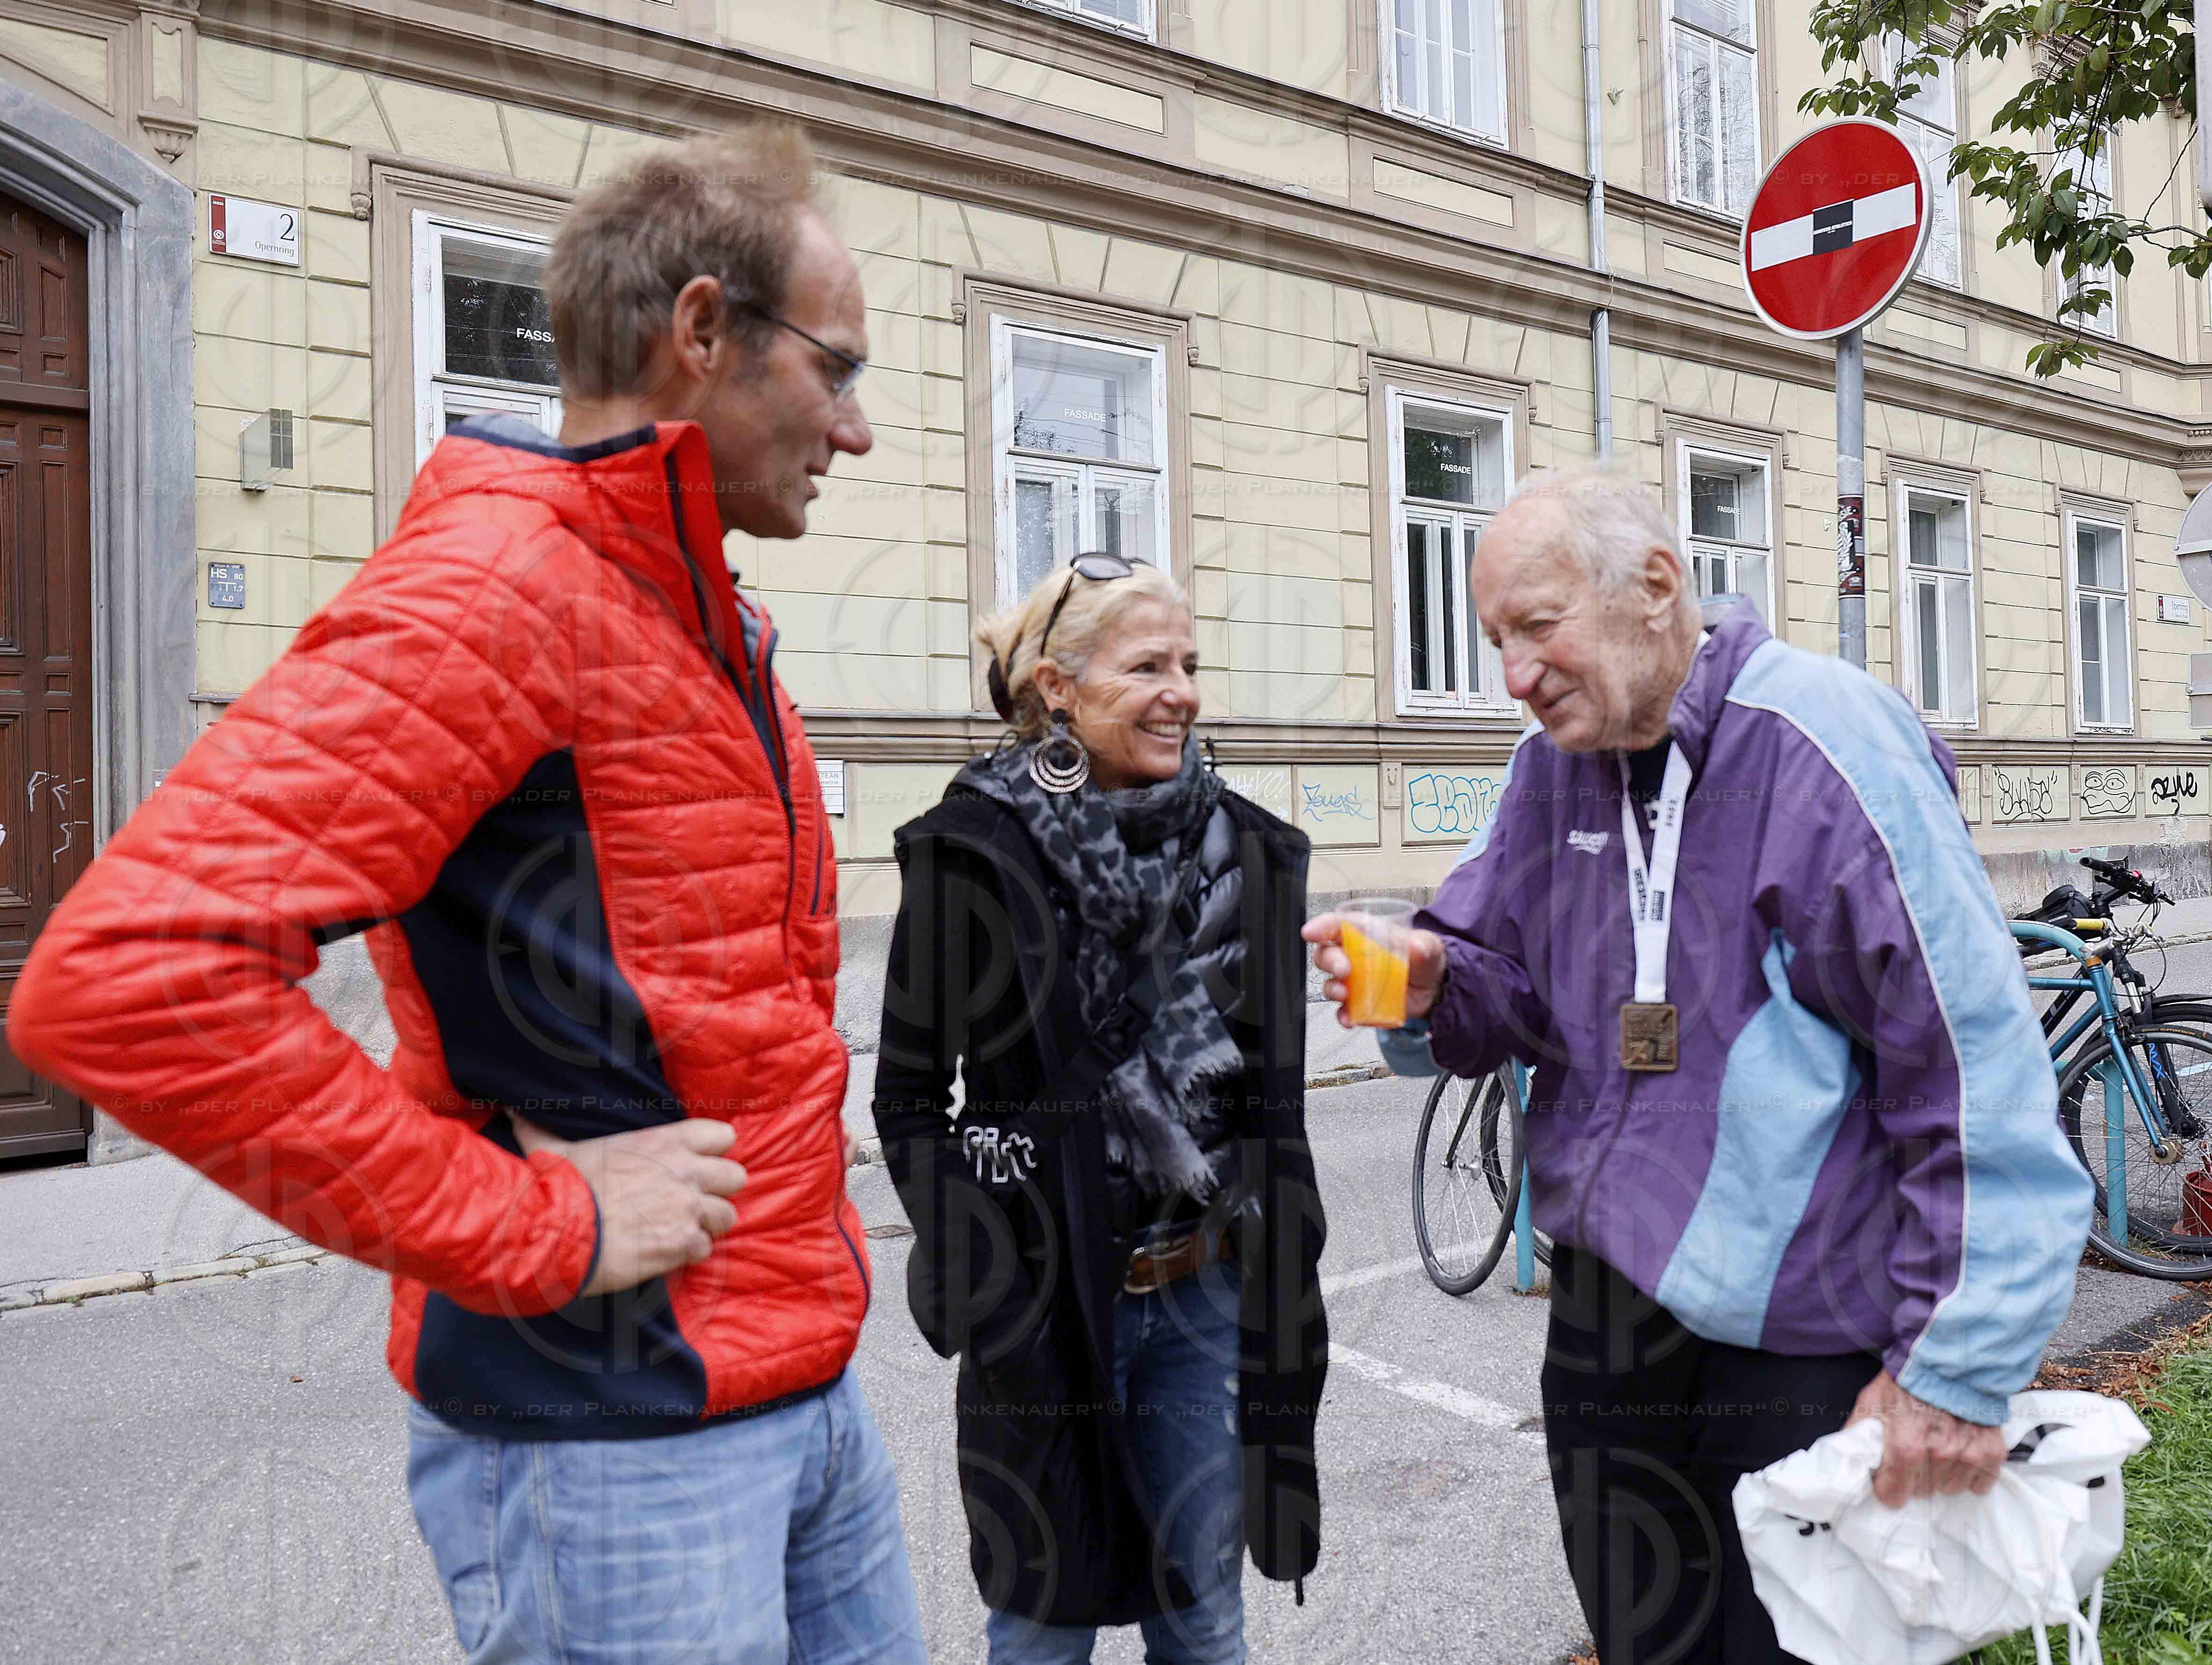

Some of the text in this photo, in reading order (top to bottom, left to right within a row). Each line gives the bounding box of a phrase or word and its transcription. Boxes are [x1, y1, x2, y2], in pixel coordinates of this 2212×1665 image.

[280, 213, 295, 241] 2
[255, 240, 295, 257] Opernring
[517, 328, 554, 343] FASS
[1064, 409, 1107, 422] FASSADE
[1441, 463, 1471, 475] FASSADE
[1717, 505, 1741, 514] FASSADE
[211, 567, 227, 578] HS
